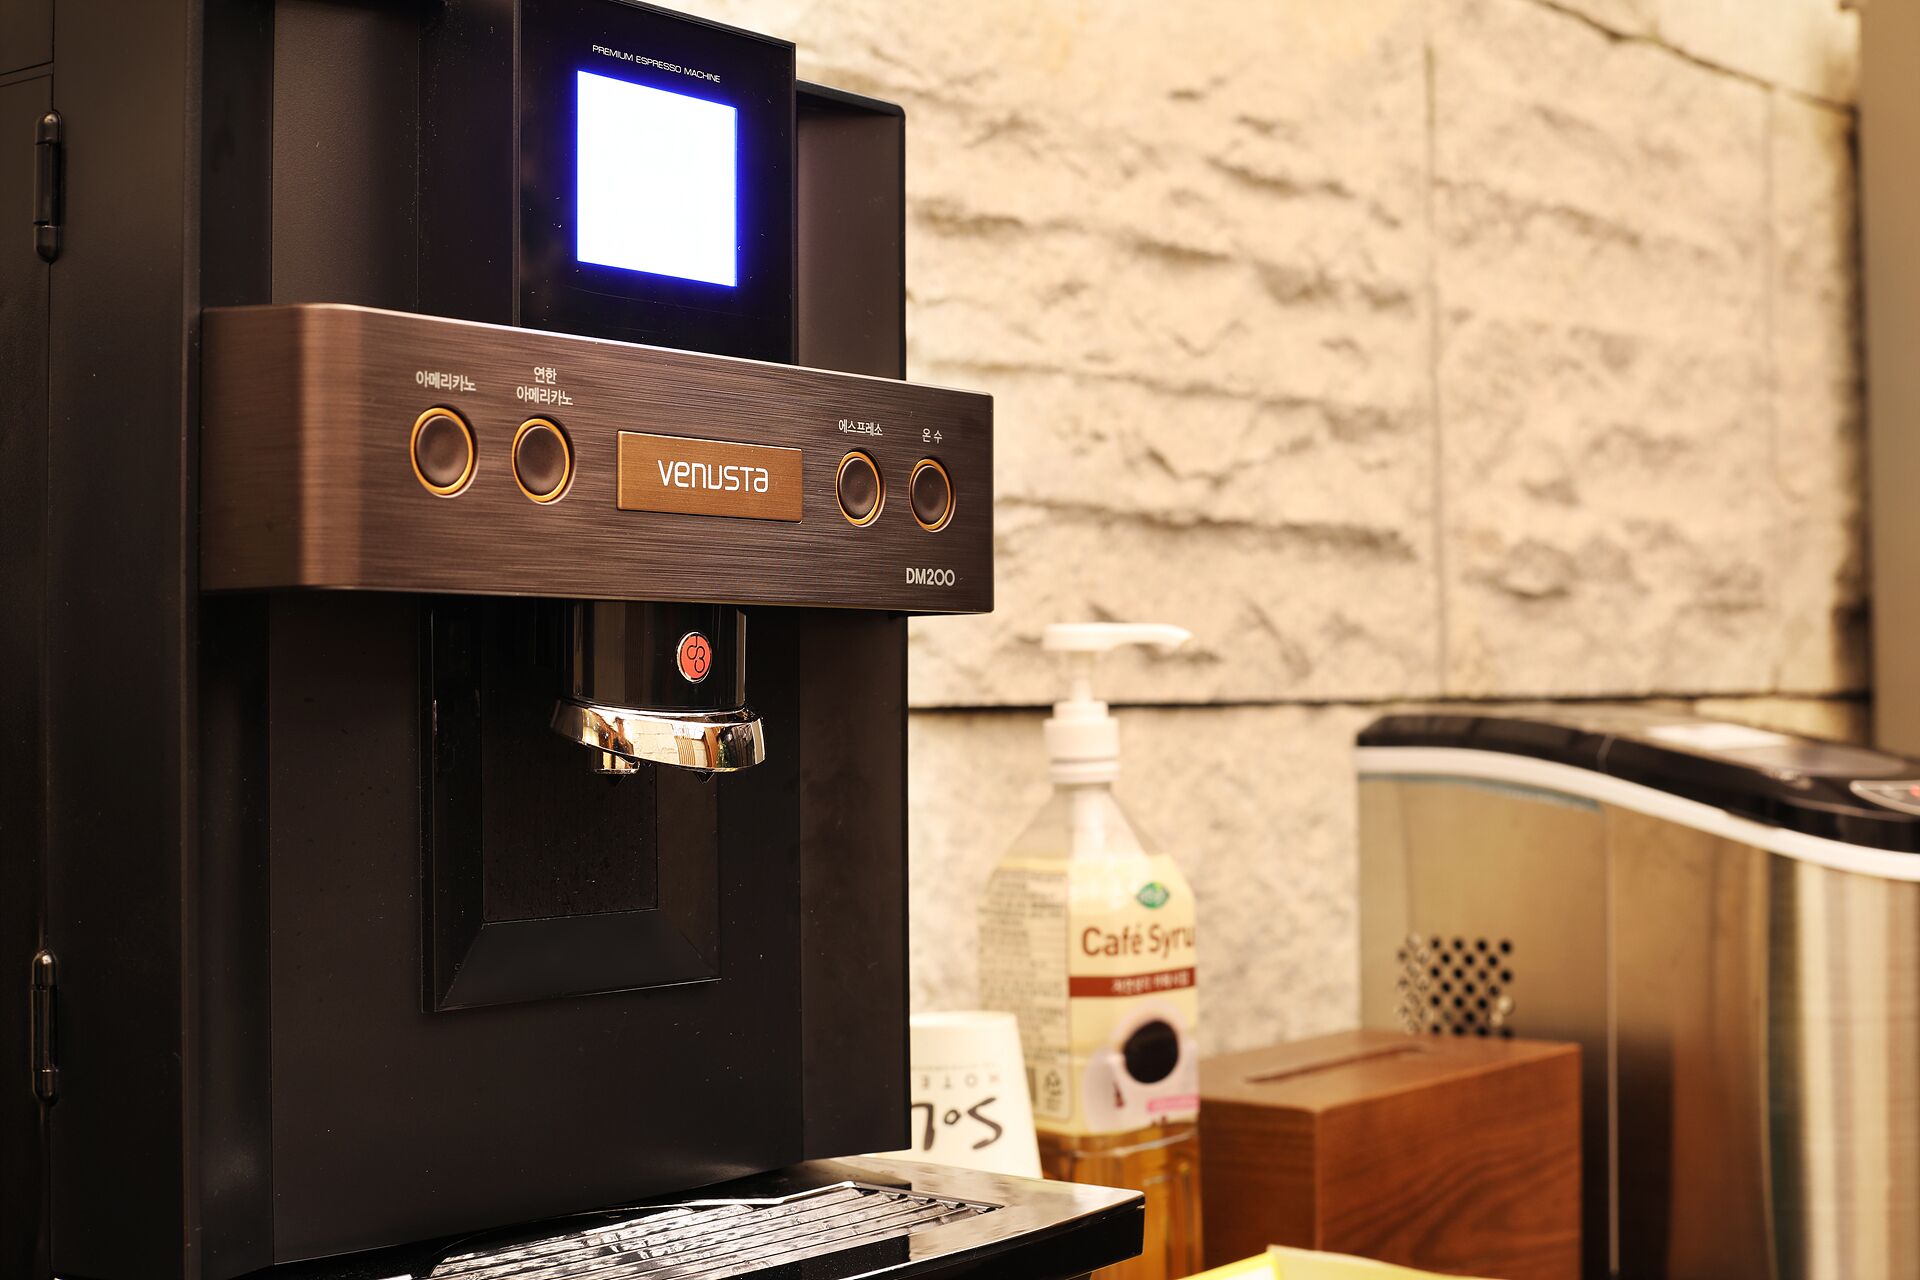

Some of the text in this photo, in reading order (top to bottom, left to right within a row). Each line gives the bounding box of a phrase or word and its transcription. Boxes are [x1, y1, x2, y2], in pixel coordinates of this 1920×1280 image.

[592, 44, 721, 84] PREMIUM ESPRESSO MACHINE
[415, 370, 477, 392] 아메리카노
[533, 366, 557, 385] 연한
[516, 385, 574, 406] 아메리카노
[838, 418, 883, 437] 에스프레소
[905, 567, 956, 587] DM200
[1082, 923, 1143, 956] Café
